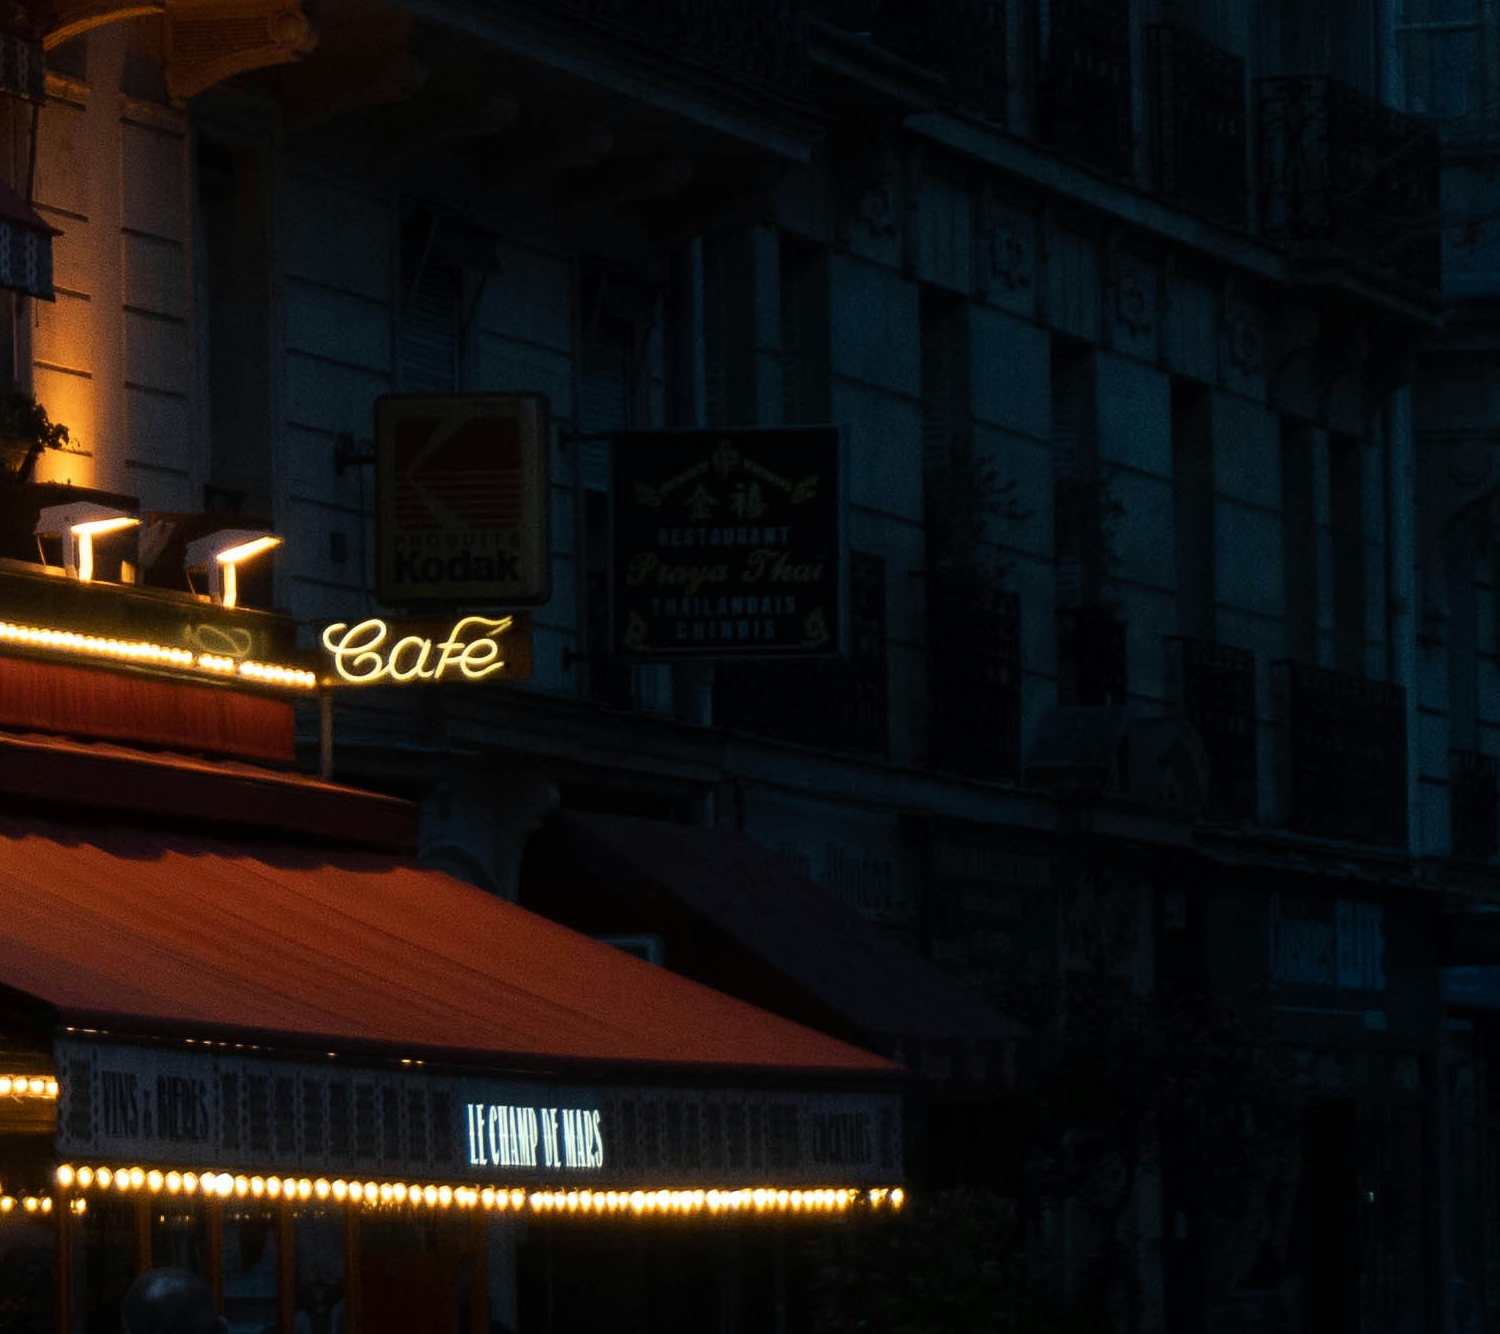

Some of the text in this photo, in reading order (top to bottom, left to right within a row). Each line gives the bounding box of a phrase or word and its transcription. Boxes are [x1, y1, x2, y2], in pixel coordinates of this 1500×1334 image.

[395, 550, 520, 583] Kodak
[655, 525, 792, 547] RESTAURANT
[321, 614, 514, 683] Café
[96, 1070, 139, 1139] VINS
[467, 1103, 604, 1168] LE CHAMP DE MARS
